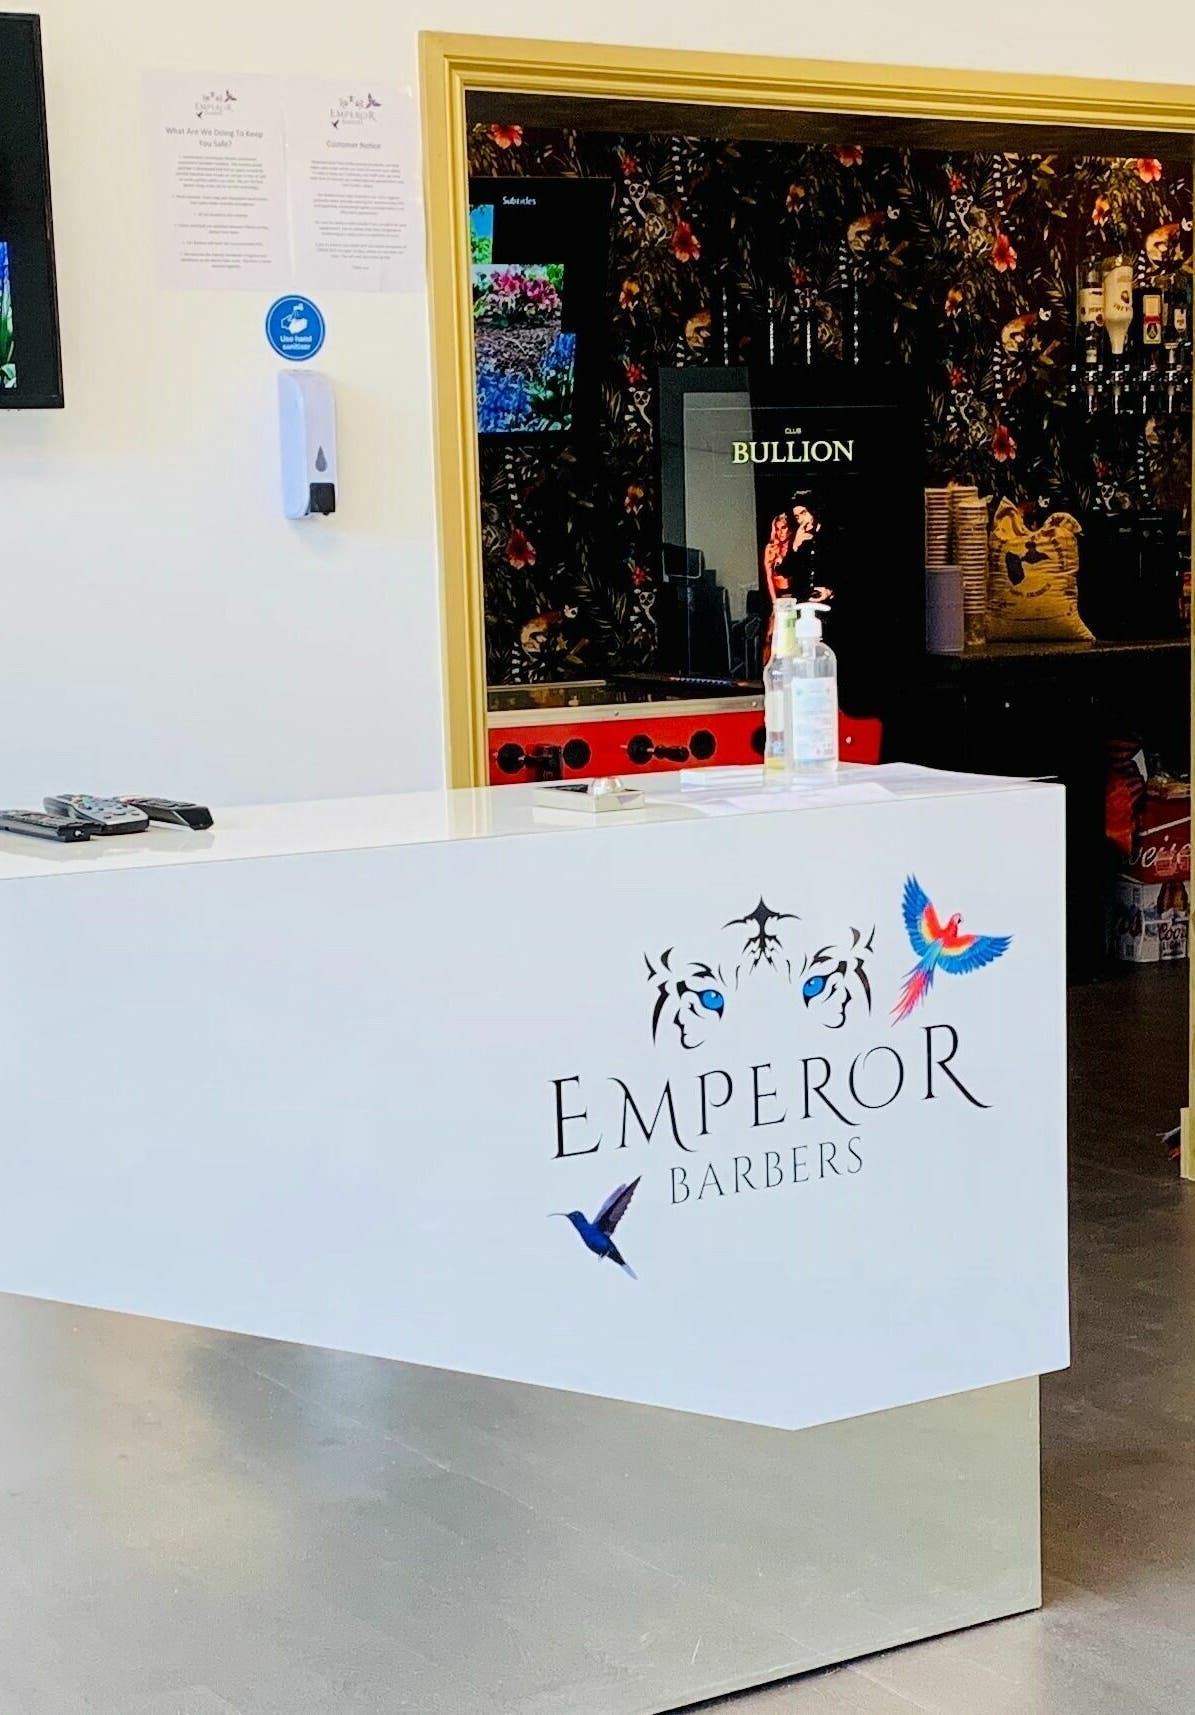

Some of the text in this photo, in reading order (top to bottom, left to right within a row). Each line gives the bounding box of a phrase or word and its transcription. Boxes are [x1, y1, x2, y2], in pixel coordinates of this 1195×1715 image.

[165, 127, 185, 135] What
[186, 127, 199, 135] Are
[784, 427, 802, 435] CLUB
[732, 439, 855, 464] BULLION
[547, 1023, 994, 1161] EMPEROR
[669, 1135, 865, 1206] BARBERS
